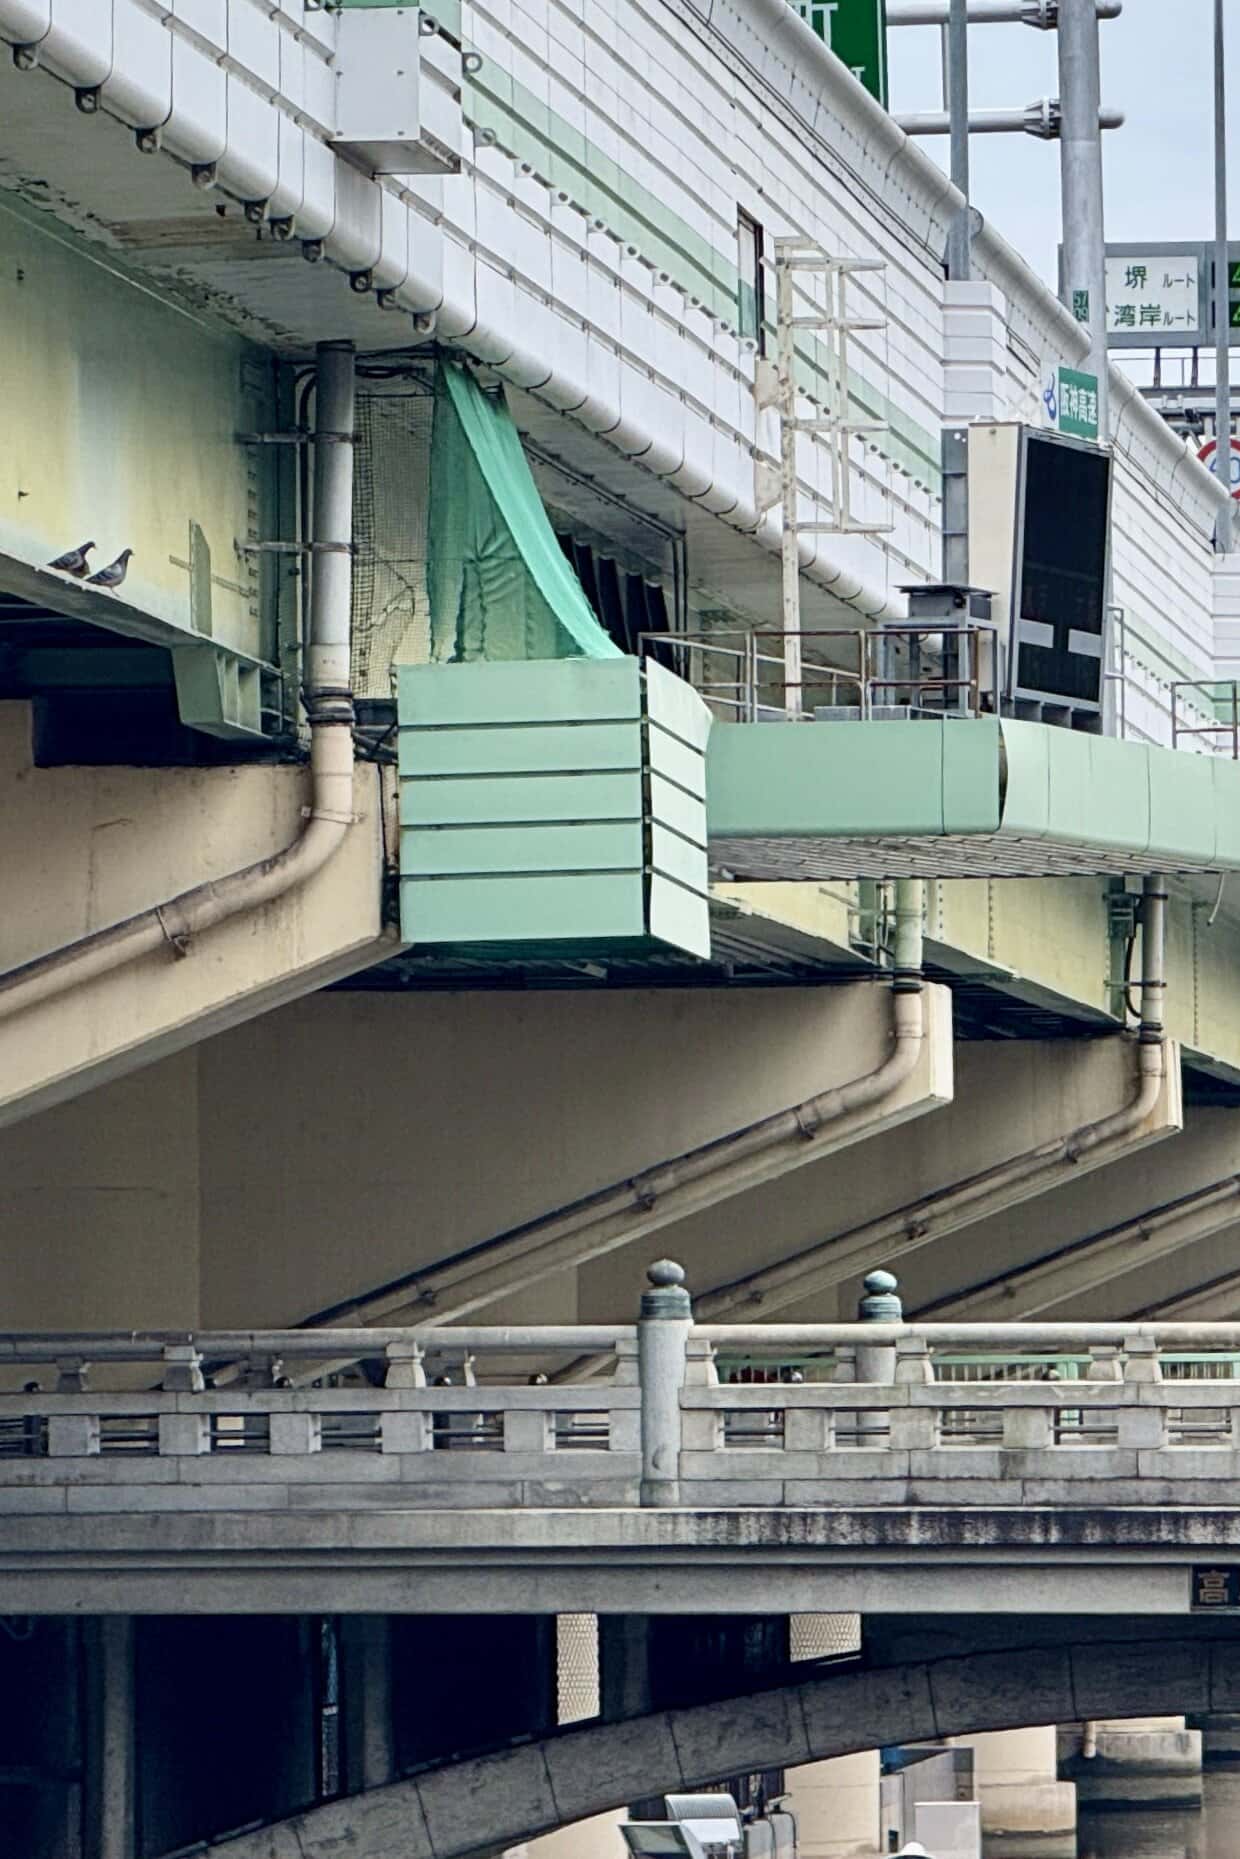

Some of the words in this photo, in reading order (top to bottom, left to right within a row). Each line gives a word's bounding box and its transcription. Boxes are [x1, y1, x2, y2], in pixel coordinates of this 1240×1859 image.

[1125, 265, 1148, 289] 堺
[1162, 272, 1196, 289] ルート
[1113, 303, 1196, 328] 湾岸ルート
[1060, 383, 1097, 424] 阪神高速
